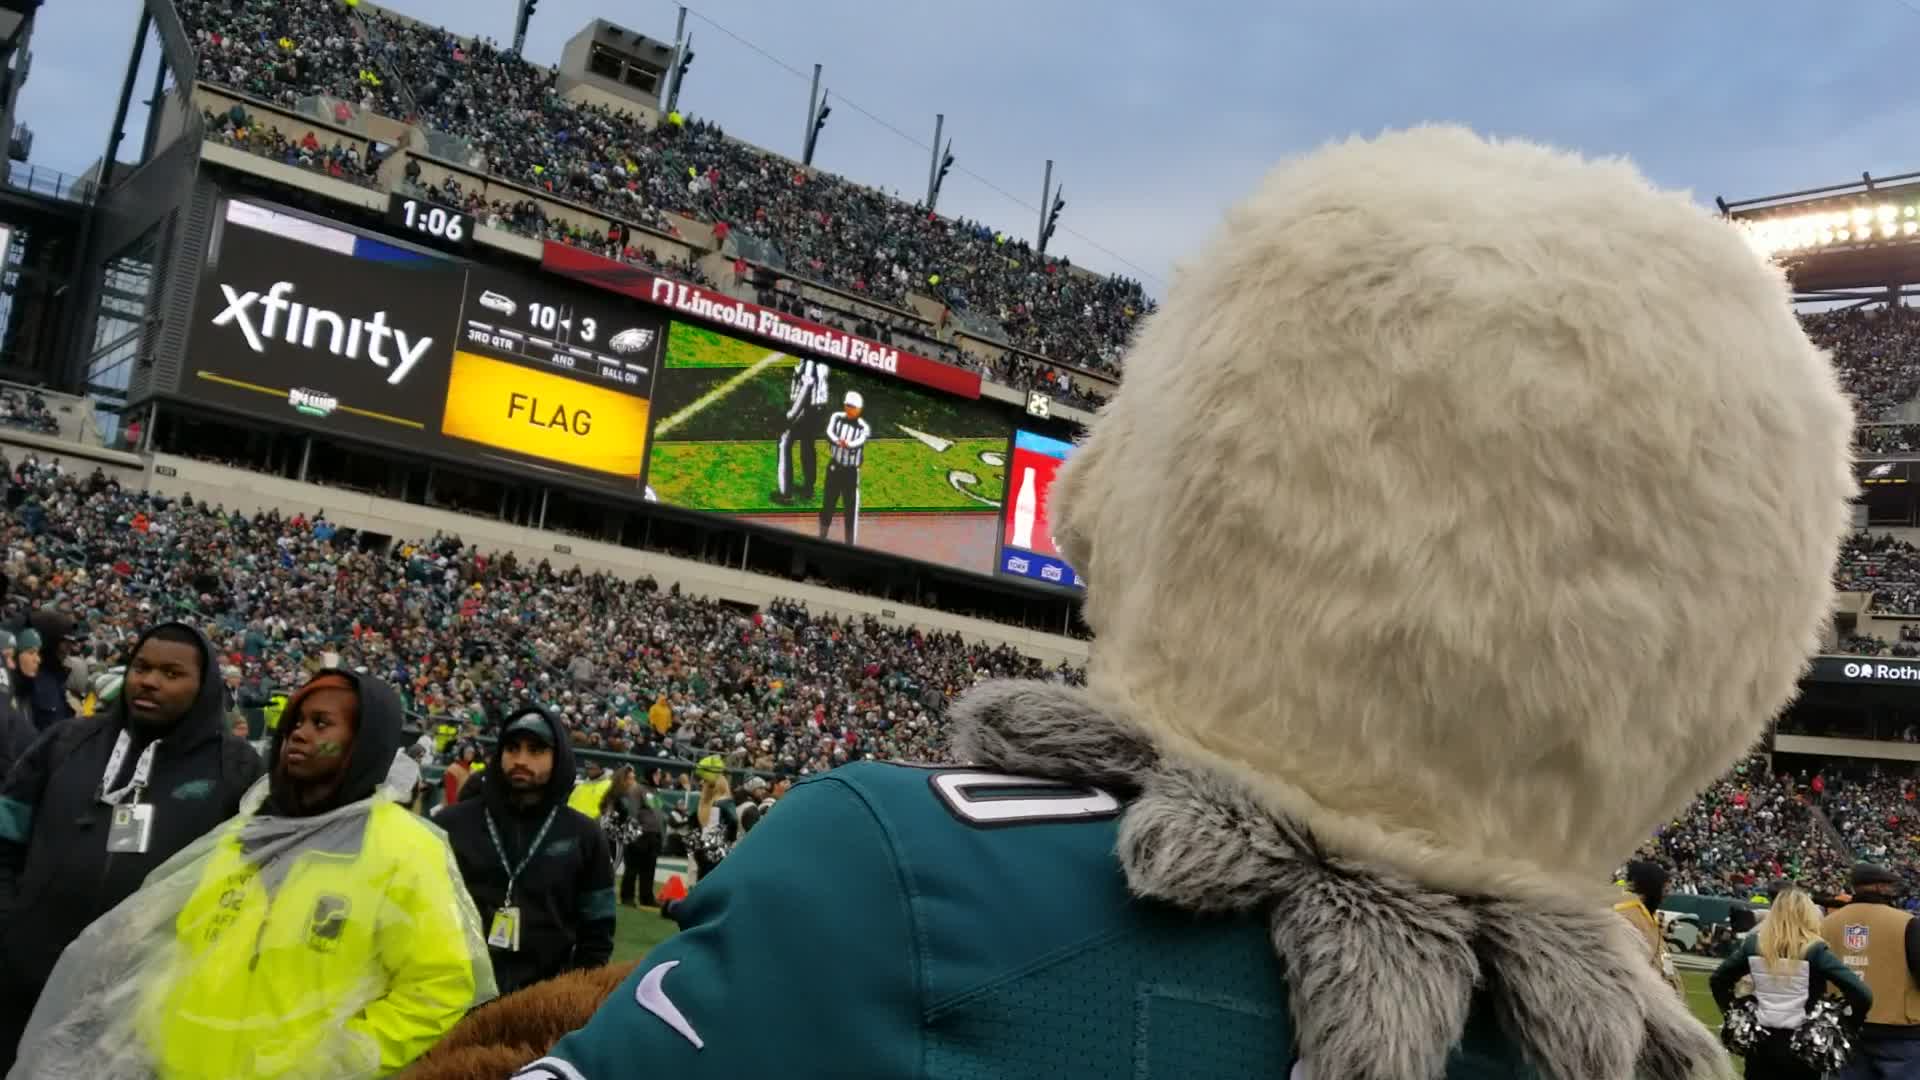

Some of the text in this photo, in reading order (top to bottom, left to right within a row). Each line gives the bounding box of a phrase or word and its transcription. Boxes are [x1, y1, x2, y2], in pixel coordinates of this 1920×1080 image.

[404, 200, 463, 241] 1:06
[211, 280, 434, 385] xfinity
[467, 329, 513, 349] 3RD QTR
[528, 302, 597, 342] 10 3
[678, 284, 899, 374] Lincoln Financial Field
[552, 354, 575, 367] AND
[602, 366, 637, 384] BALL ON
[507, 391, 592, 437] FLAG
